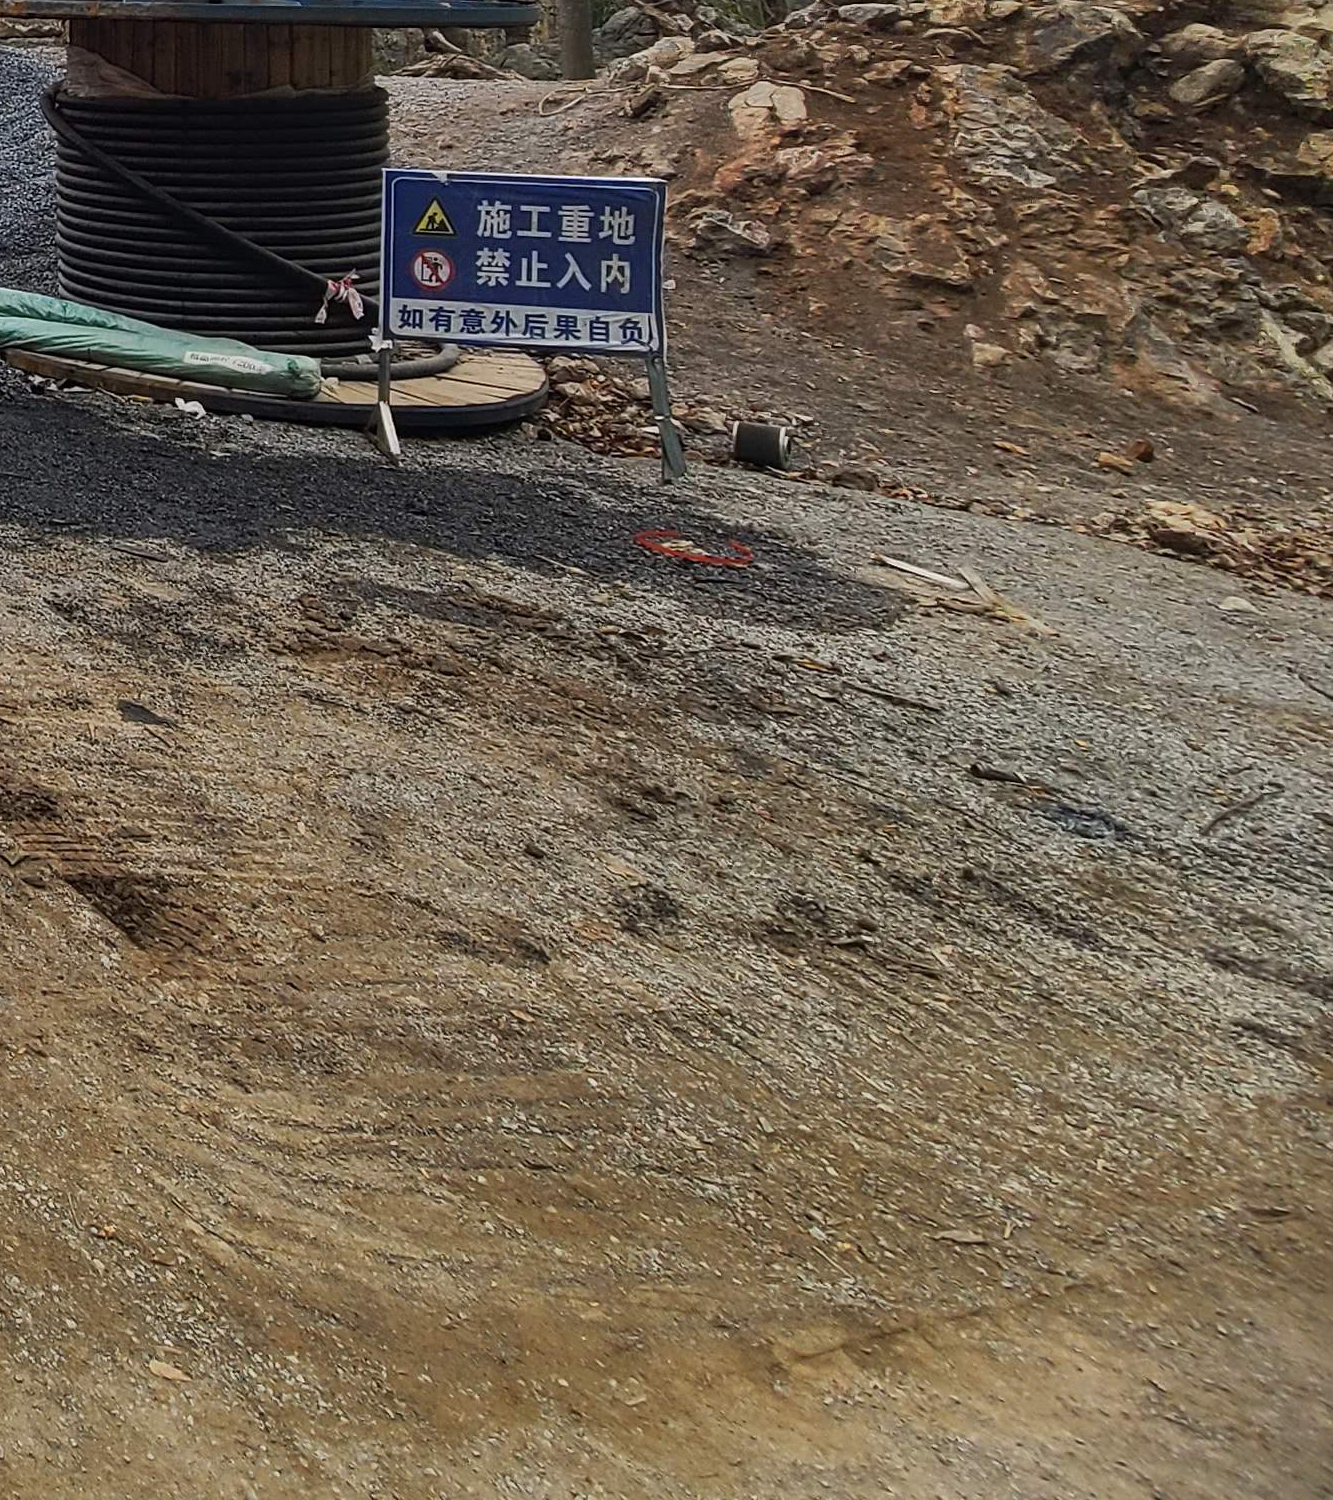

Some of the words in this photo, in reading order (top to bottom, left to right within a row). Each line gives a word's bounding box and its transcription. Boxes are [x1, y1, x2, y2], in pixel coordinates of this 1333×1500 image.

[476, 199, 636, 245] 施工重地
[475, 247, 631, 294] 禁止入内
[397, 304, 644, 345] 如有意外后果自负
